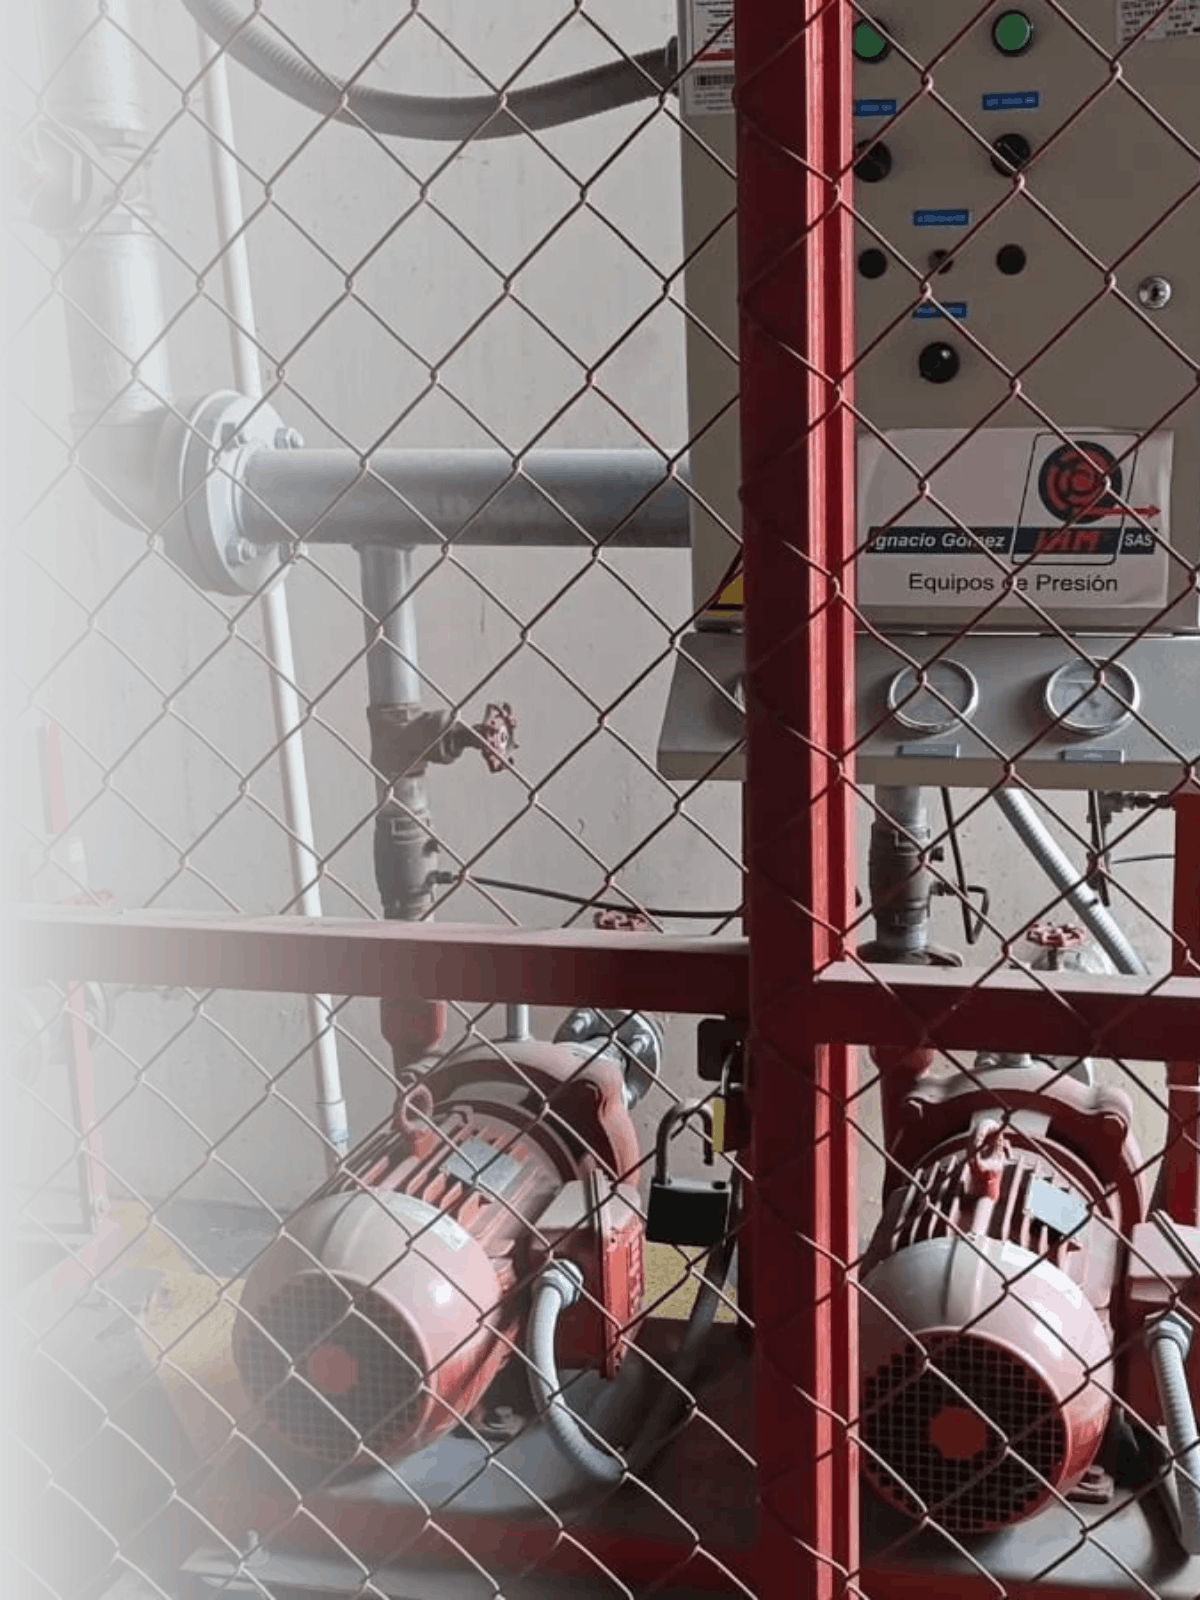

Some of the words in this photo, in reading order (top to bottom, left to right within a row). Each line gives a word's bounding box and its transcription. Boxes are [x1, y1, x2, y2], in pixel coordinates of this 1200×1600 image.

[870, 532, 936, 550] gnacio
[1124, 532, 1154, 547] SAS
[909, 573, 994, 594] Equipos
[1036, 573, 1118, 592] Presión
